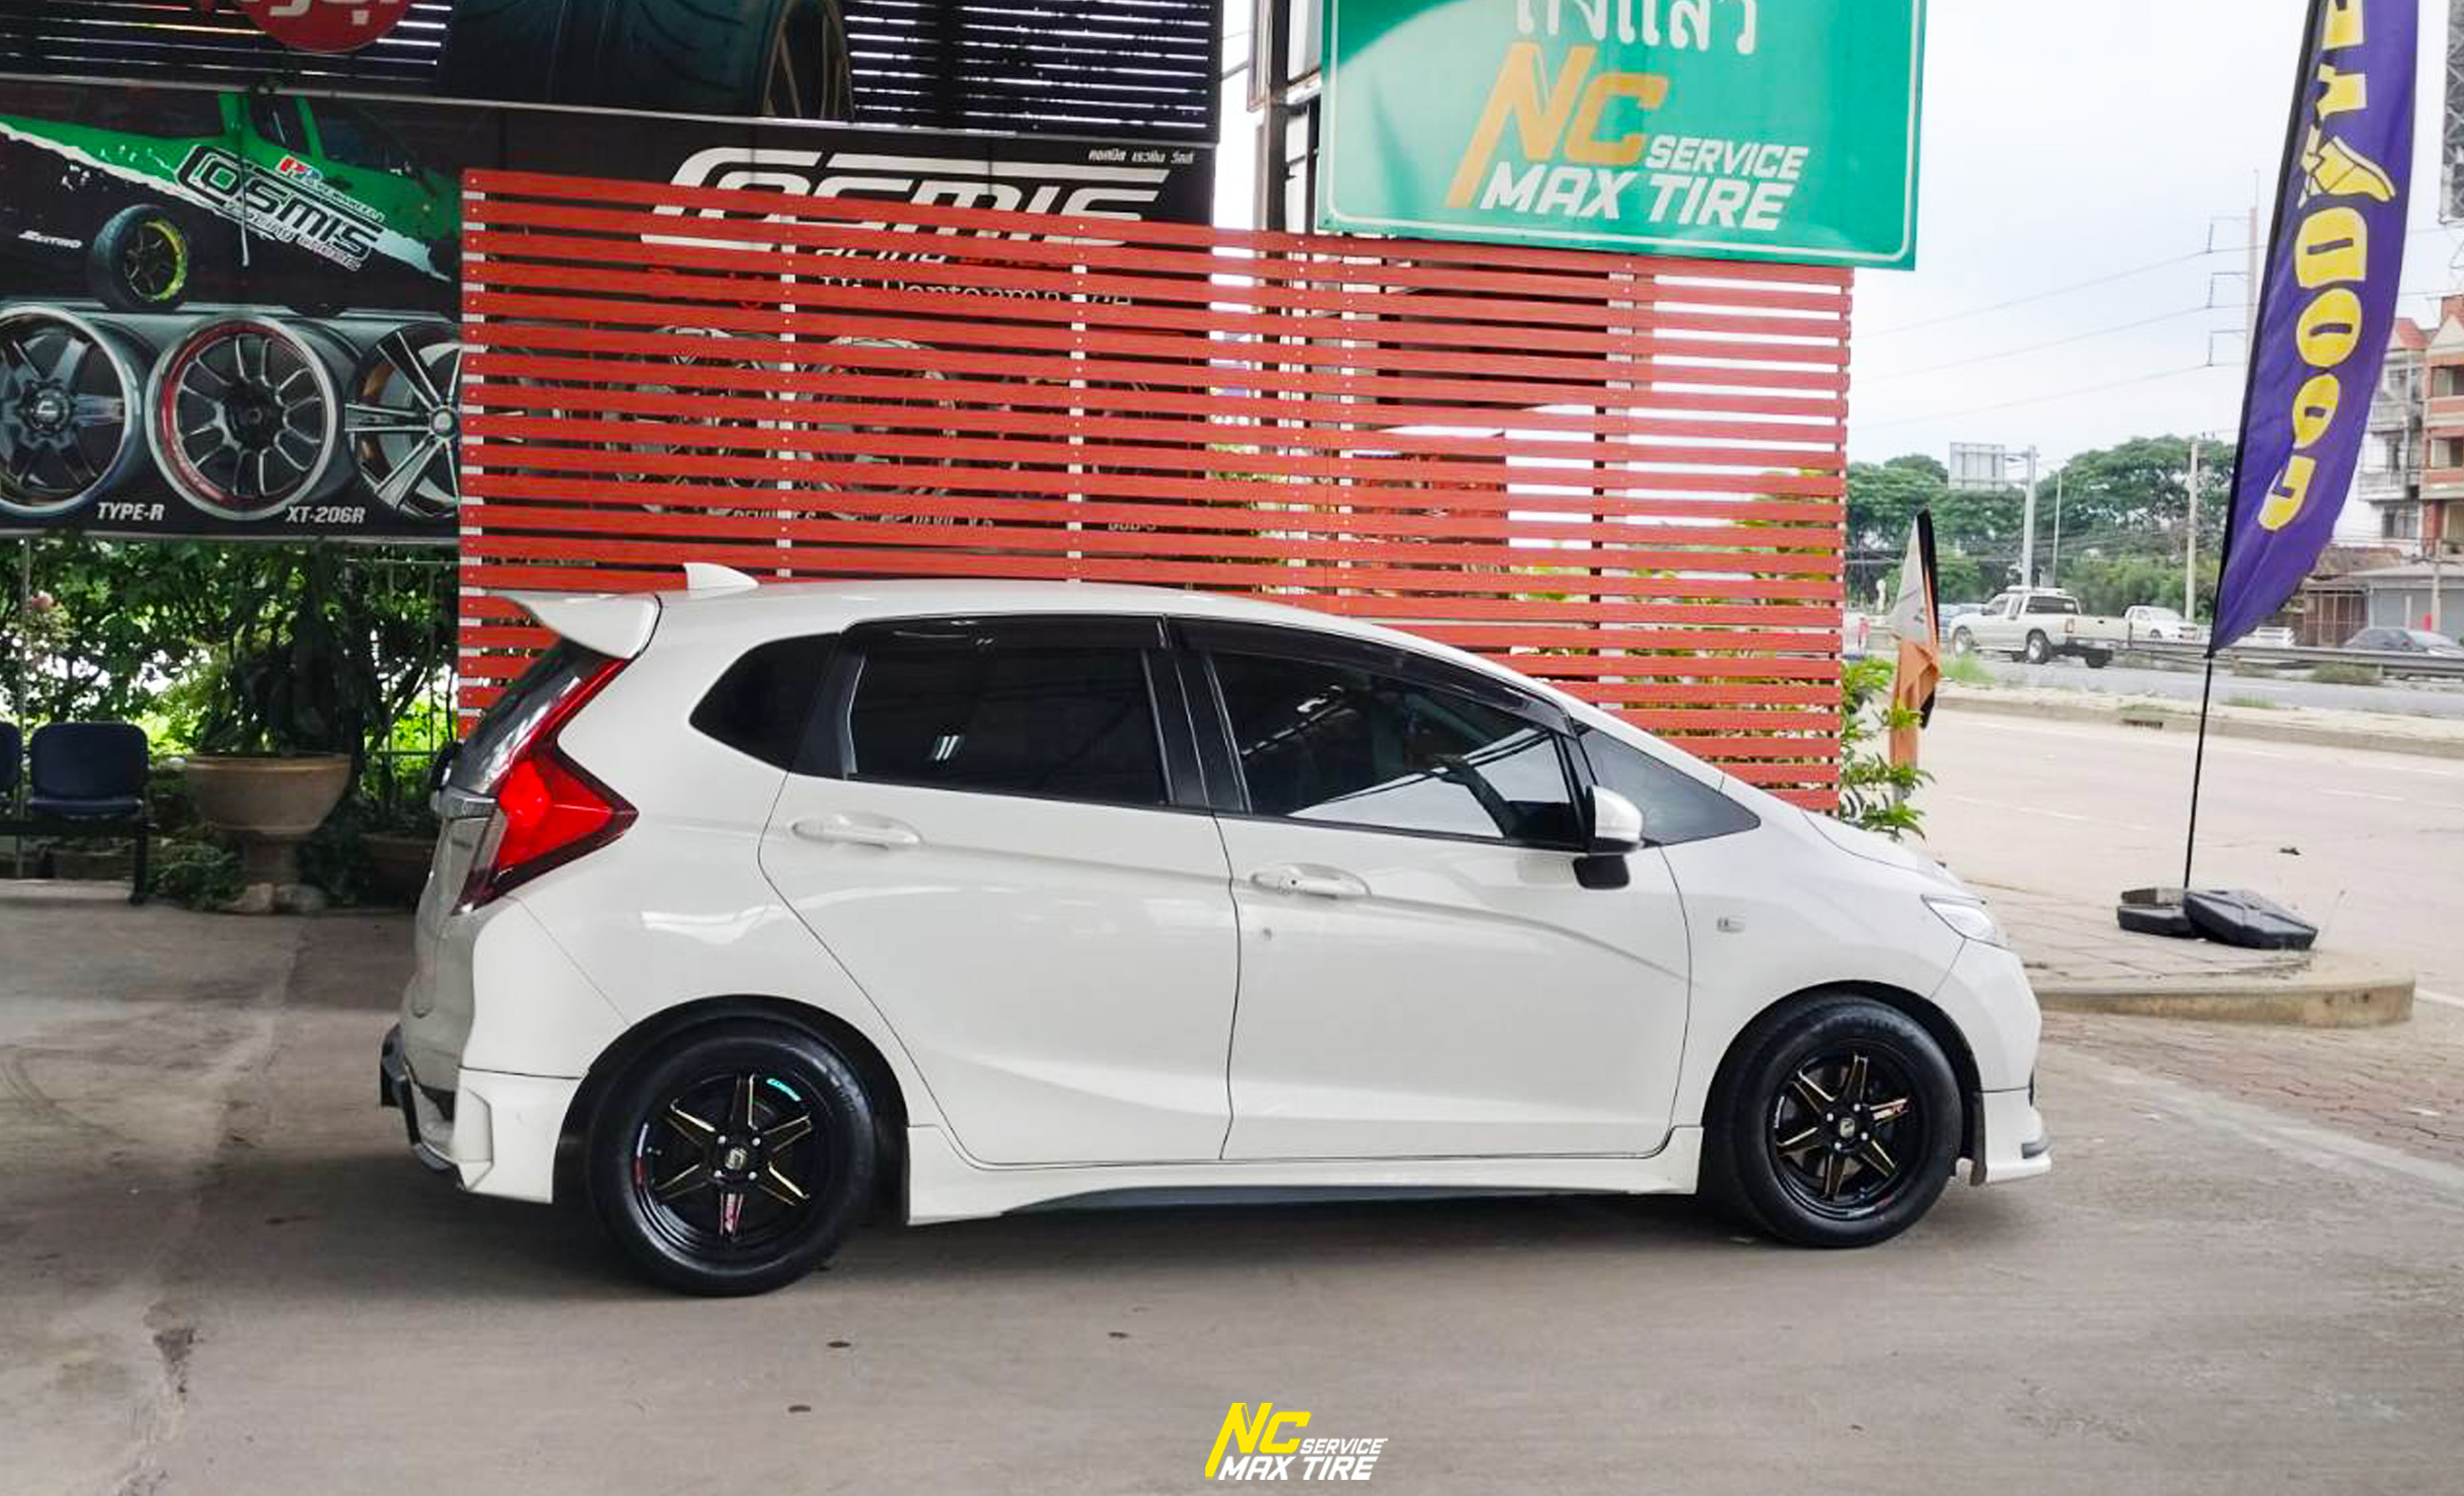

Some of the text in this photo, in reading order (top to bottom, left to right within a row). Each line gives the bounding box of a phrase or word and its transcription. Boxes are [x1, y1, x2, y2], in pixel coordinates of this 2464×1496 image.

[1446, 41, 1669, 209] NC
[1646, 134, 1809, 181] SERVICE
[1479, 161, 1795, 231] MAX TIRE
[97, 502, 165, 522] TYPE-R
[285, 506, 366, 524] XT-206R
